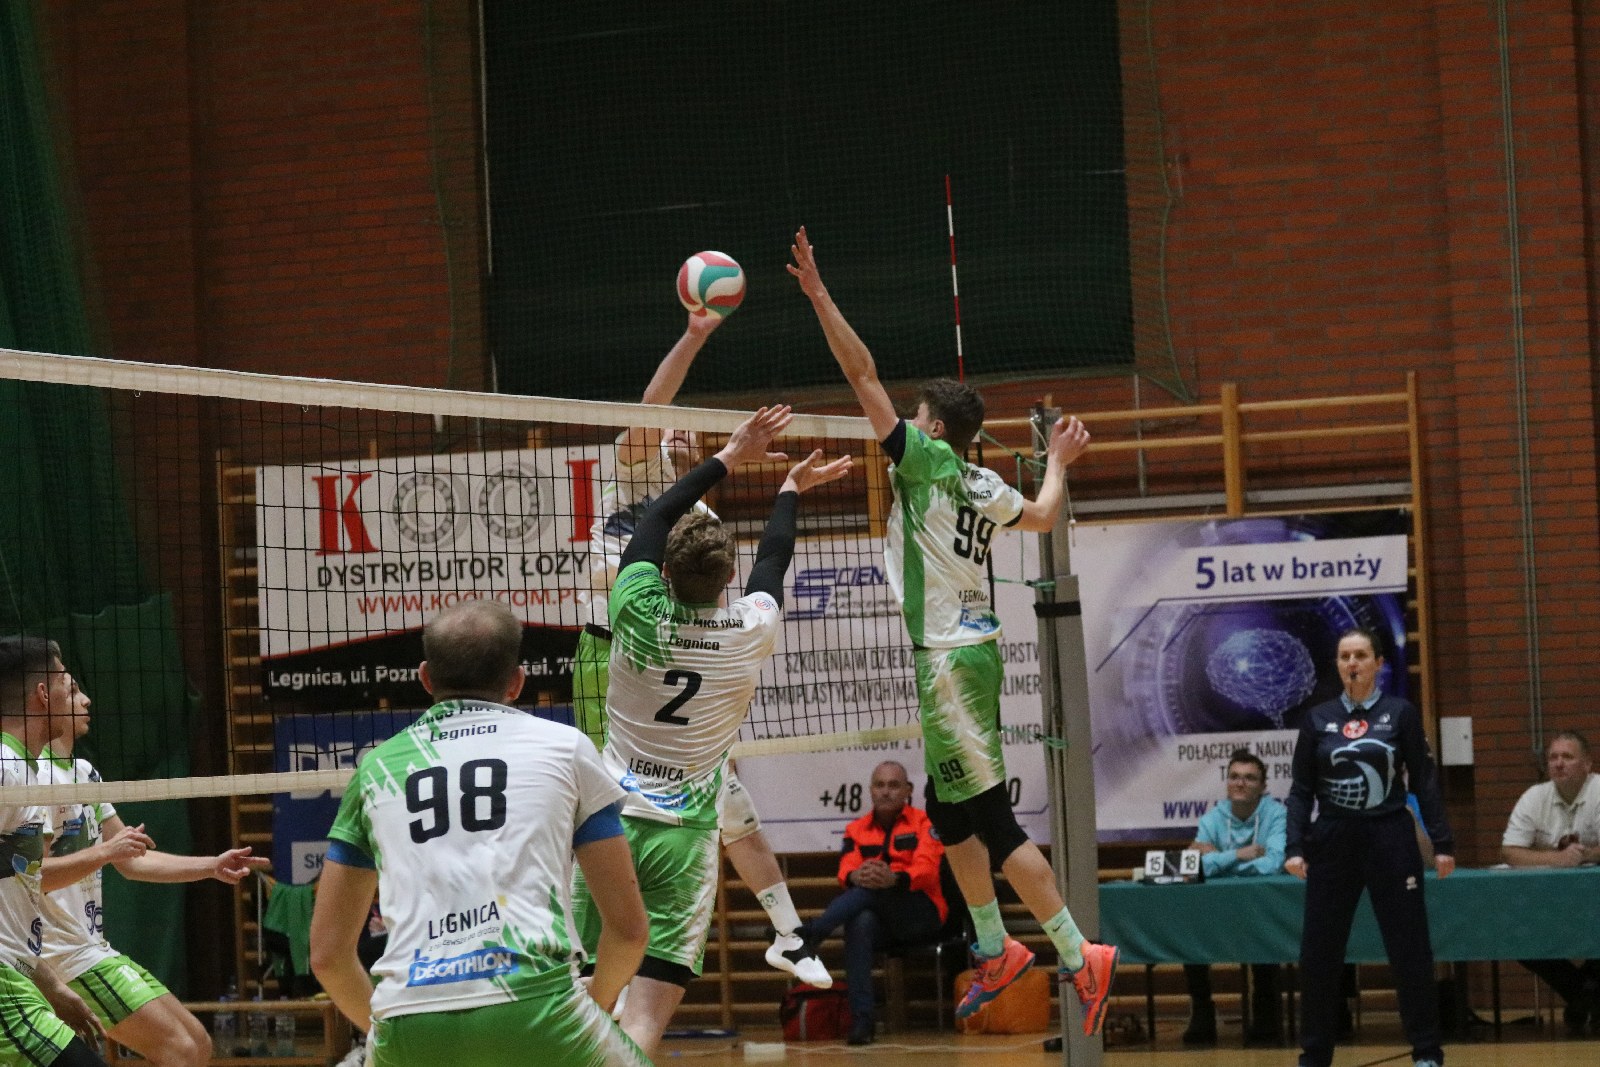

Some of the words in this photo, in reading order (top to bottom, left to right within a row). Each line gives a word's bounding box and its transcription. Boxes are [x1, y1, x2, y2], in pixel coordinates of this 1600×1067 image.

[953, 505, 997, 566] 99
[316, 557, 505, 588] DYSTRYBUTOR
[520, 548, 589, 577] ŁOŻY
[1196, 556, 1216, 590] 5
[1223, 560, 1256, 583] lat
[1262, 564, 1285, 581] w
[1292, 553, 1382, 581] branży
[357, 587, 584, 615] WWW.KOCOM.PL
[668, 633, 720, 651] Legnica
[785, 651, 851, 674] SZKOLENIA
[870, 648, 915, 671] DZIEDZ
[270, 666, 347, 691] Legnica,
[375, 665, 420, 683] Pozn
[895, 680, 916, 700] MA
[654, 669, 702, 725] 2
[430, 724, 497, 743] Legnica
[629, 757, 684, 782] LEGNICA
[939, 758, 966, 783] 99
[405, 758, 508, 844] 98
[819, 782, 863, 813] +48
[1163, 800, 1208, 819] WWW
[304, 852, 327, 869] SK
[413, 952, 513, 981] DECATHLON
